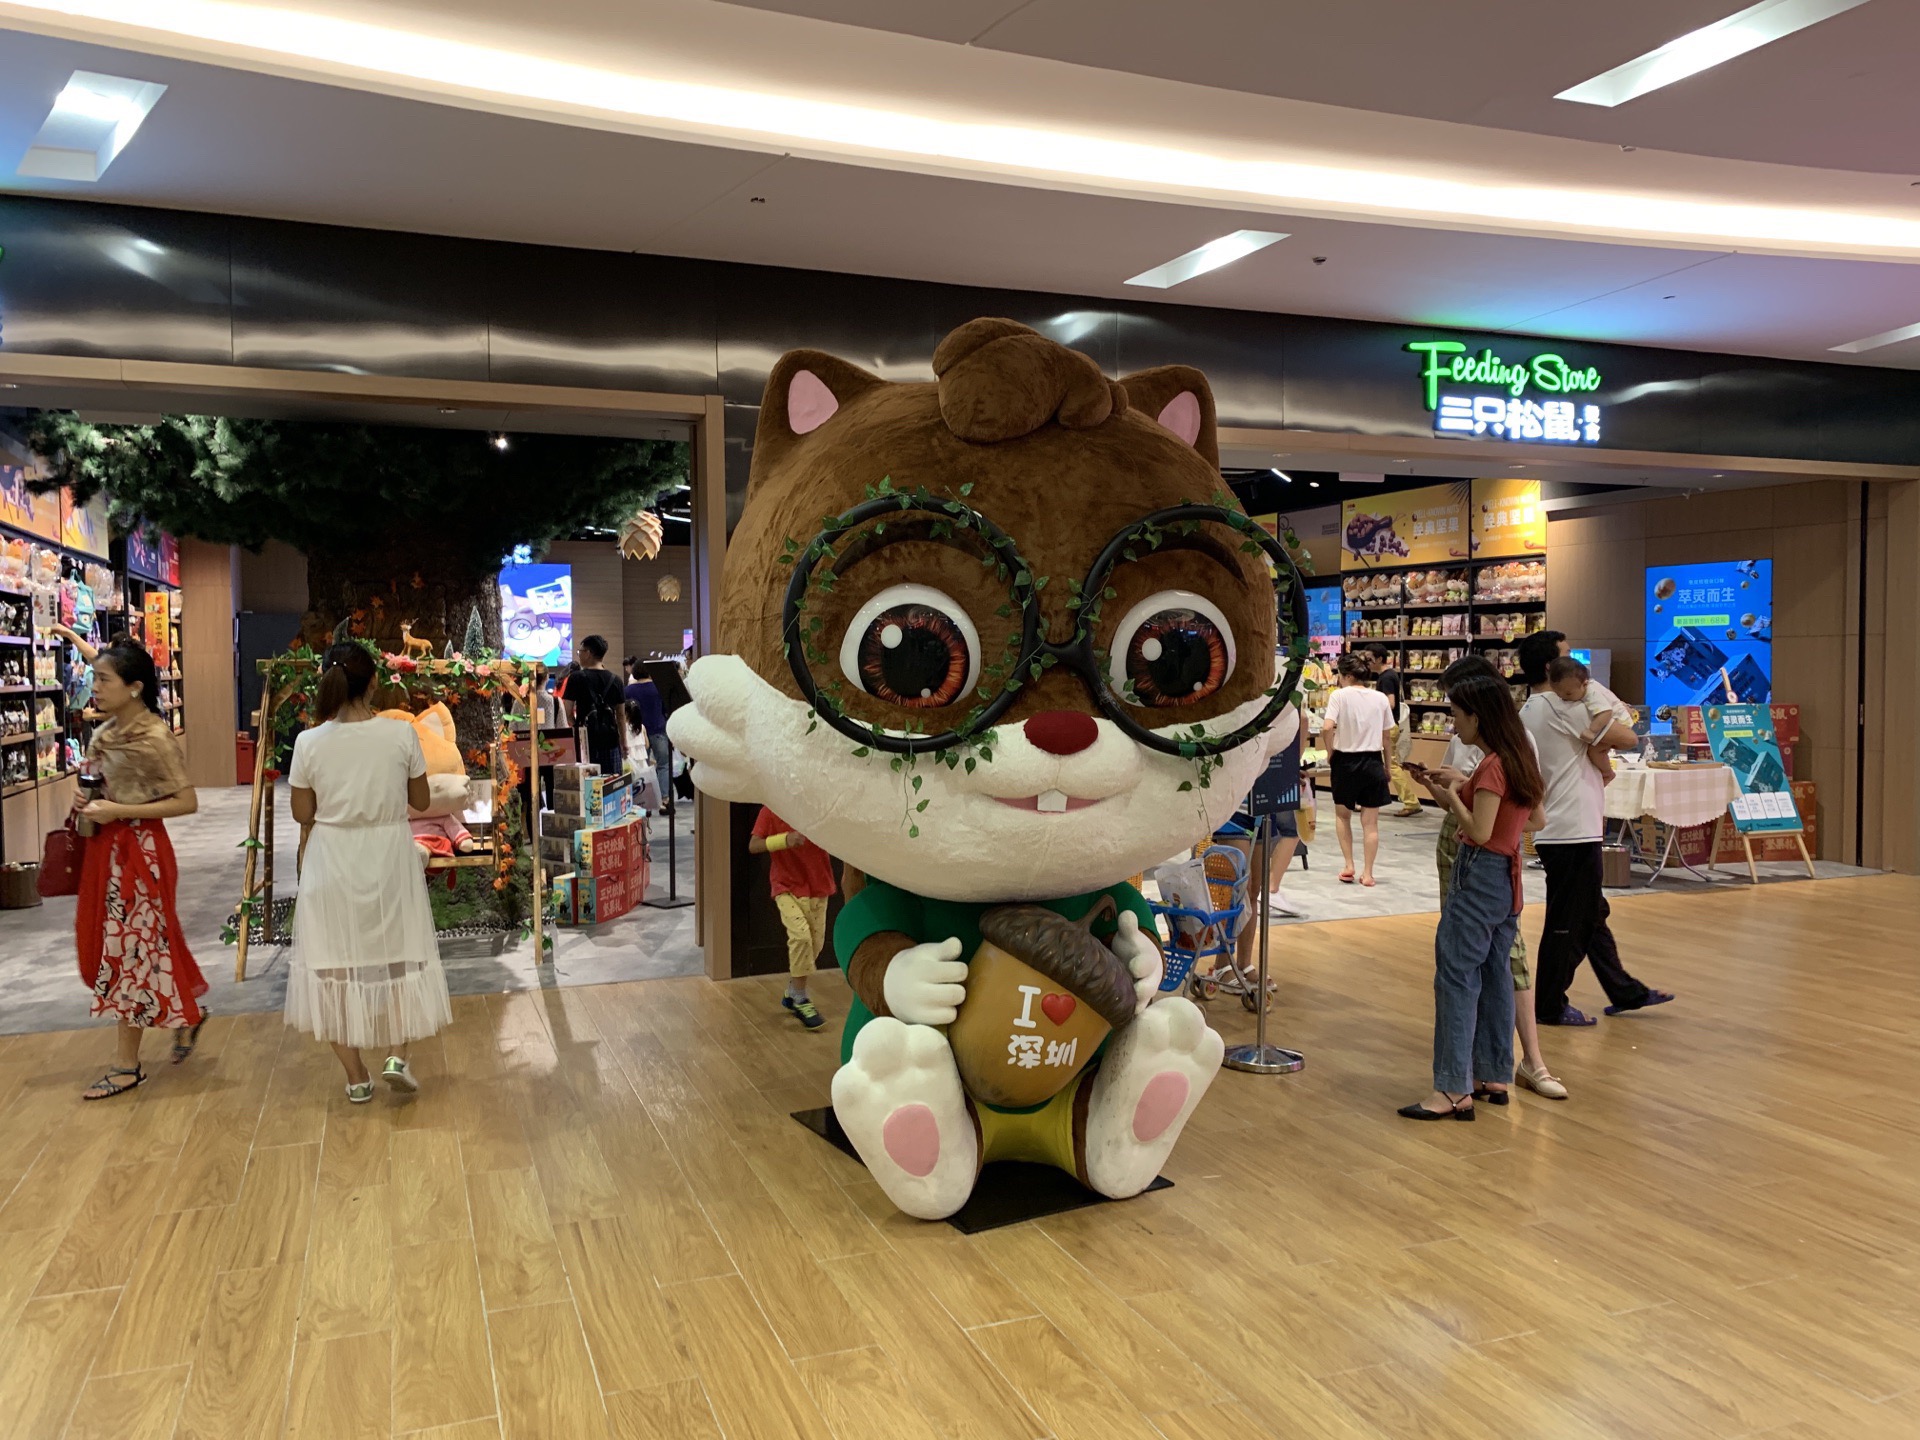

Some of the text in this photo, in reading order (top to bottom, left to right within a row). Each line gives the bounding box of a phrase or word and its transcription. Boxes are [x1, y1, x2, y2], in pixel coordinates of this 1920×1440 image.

[1408, 341, 1601, 411] Feeding Store
[1440, 395, 1580, 441] 三只松鼠
[1413, 517, 1460, 537] 经典坚果
[1678, 587, 1736, 604] 萃灵而生
[596, 837, 626, 855] 三只松鼠
[1765, 838, 1797, 850] 坚果礼
[600, 855, 622, 872] 坚果礼
[599, 881, 626, 901] 三只松鼠
[602, 900, 622, 918] 坚果礼
[1013, 985, 1041, 1028] I
[1007, 1034, 1078, 1070] 深圳
